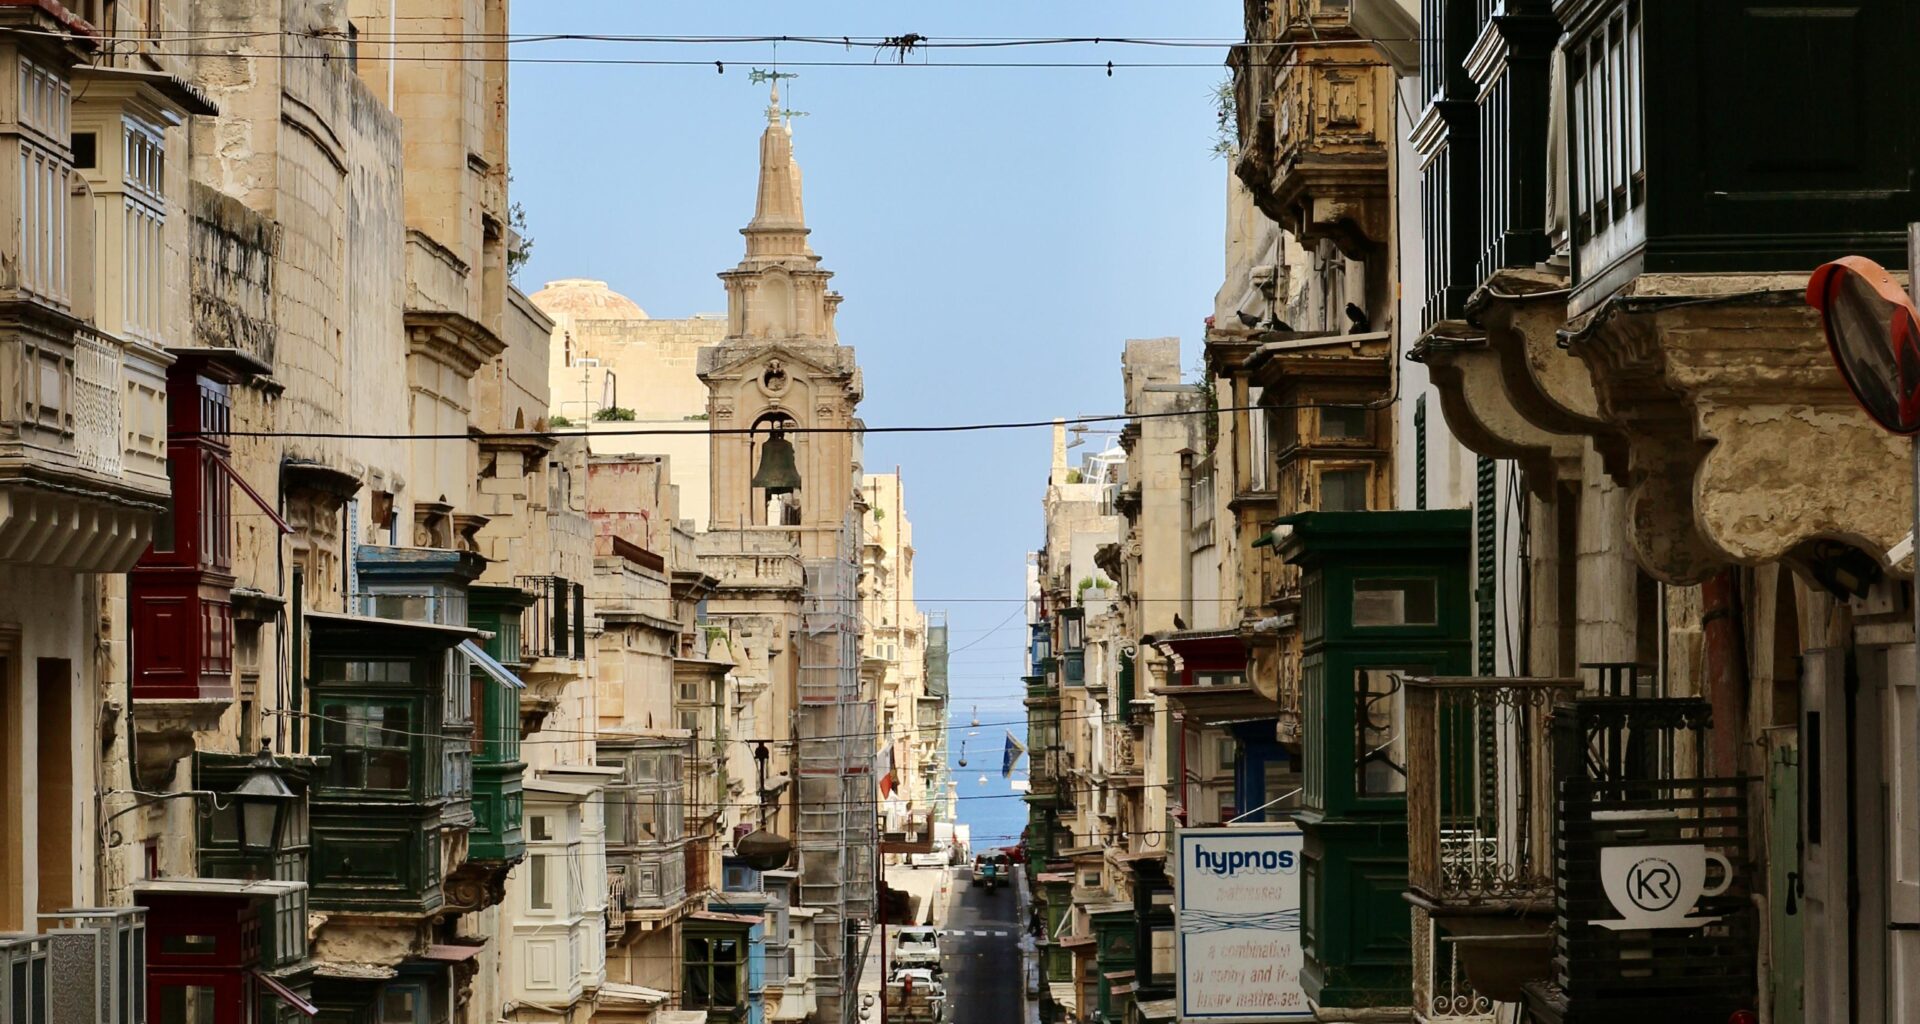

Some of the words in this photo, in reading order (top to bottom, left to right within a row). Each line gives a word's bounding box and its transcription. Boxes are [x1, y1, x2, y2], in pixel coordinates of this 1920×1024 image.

[1196, 844, 1294, 875] hypnos
[1637, 869, 1673, 900] KR
[1208, 944, 1216, 959] a
[1250, 964, 1273, 983] and
